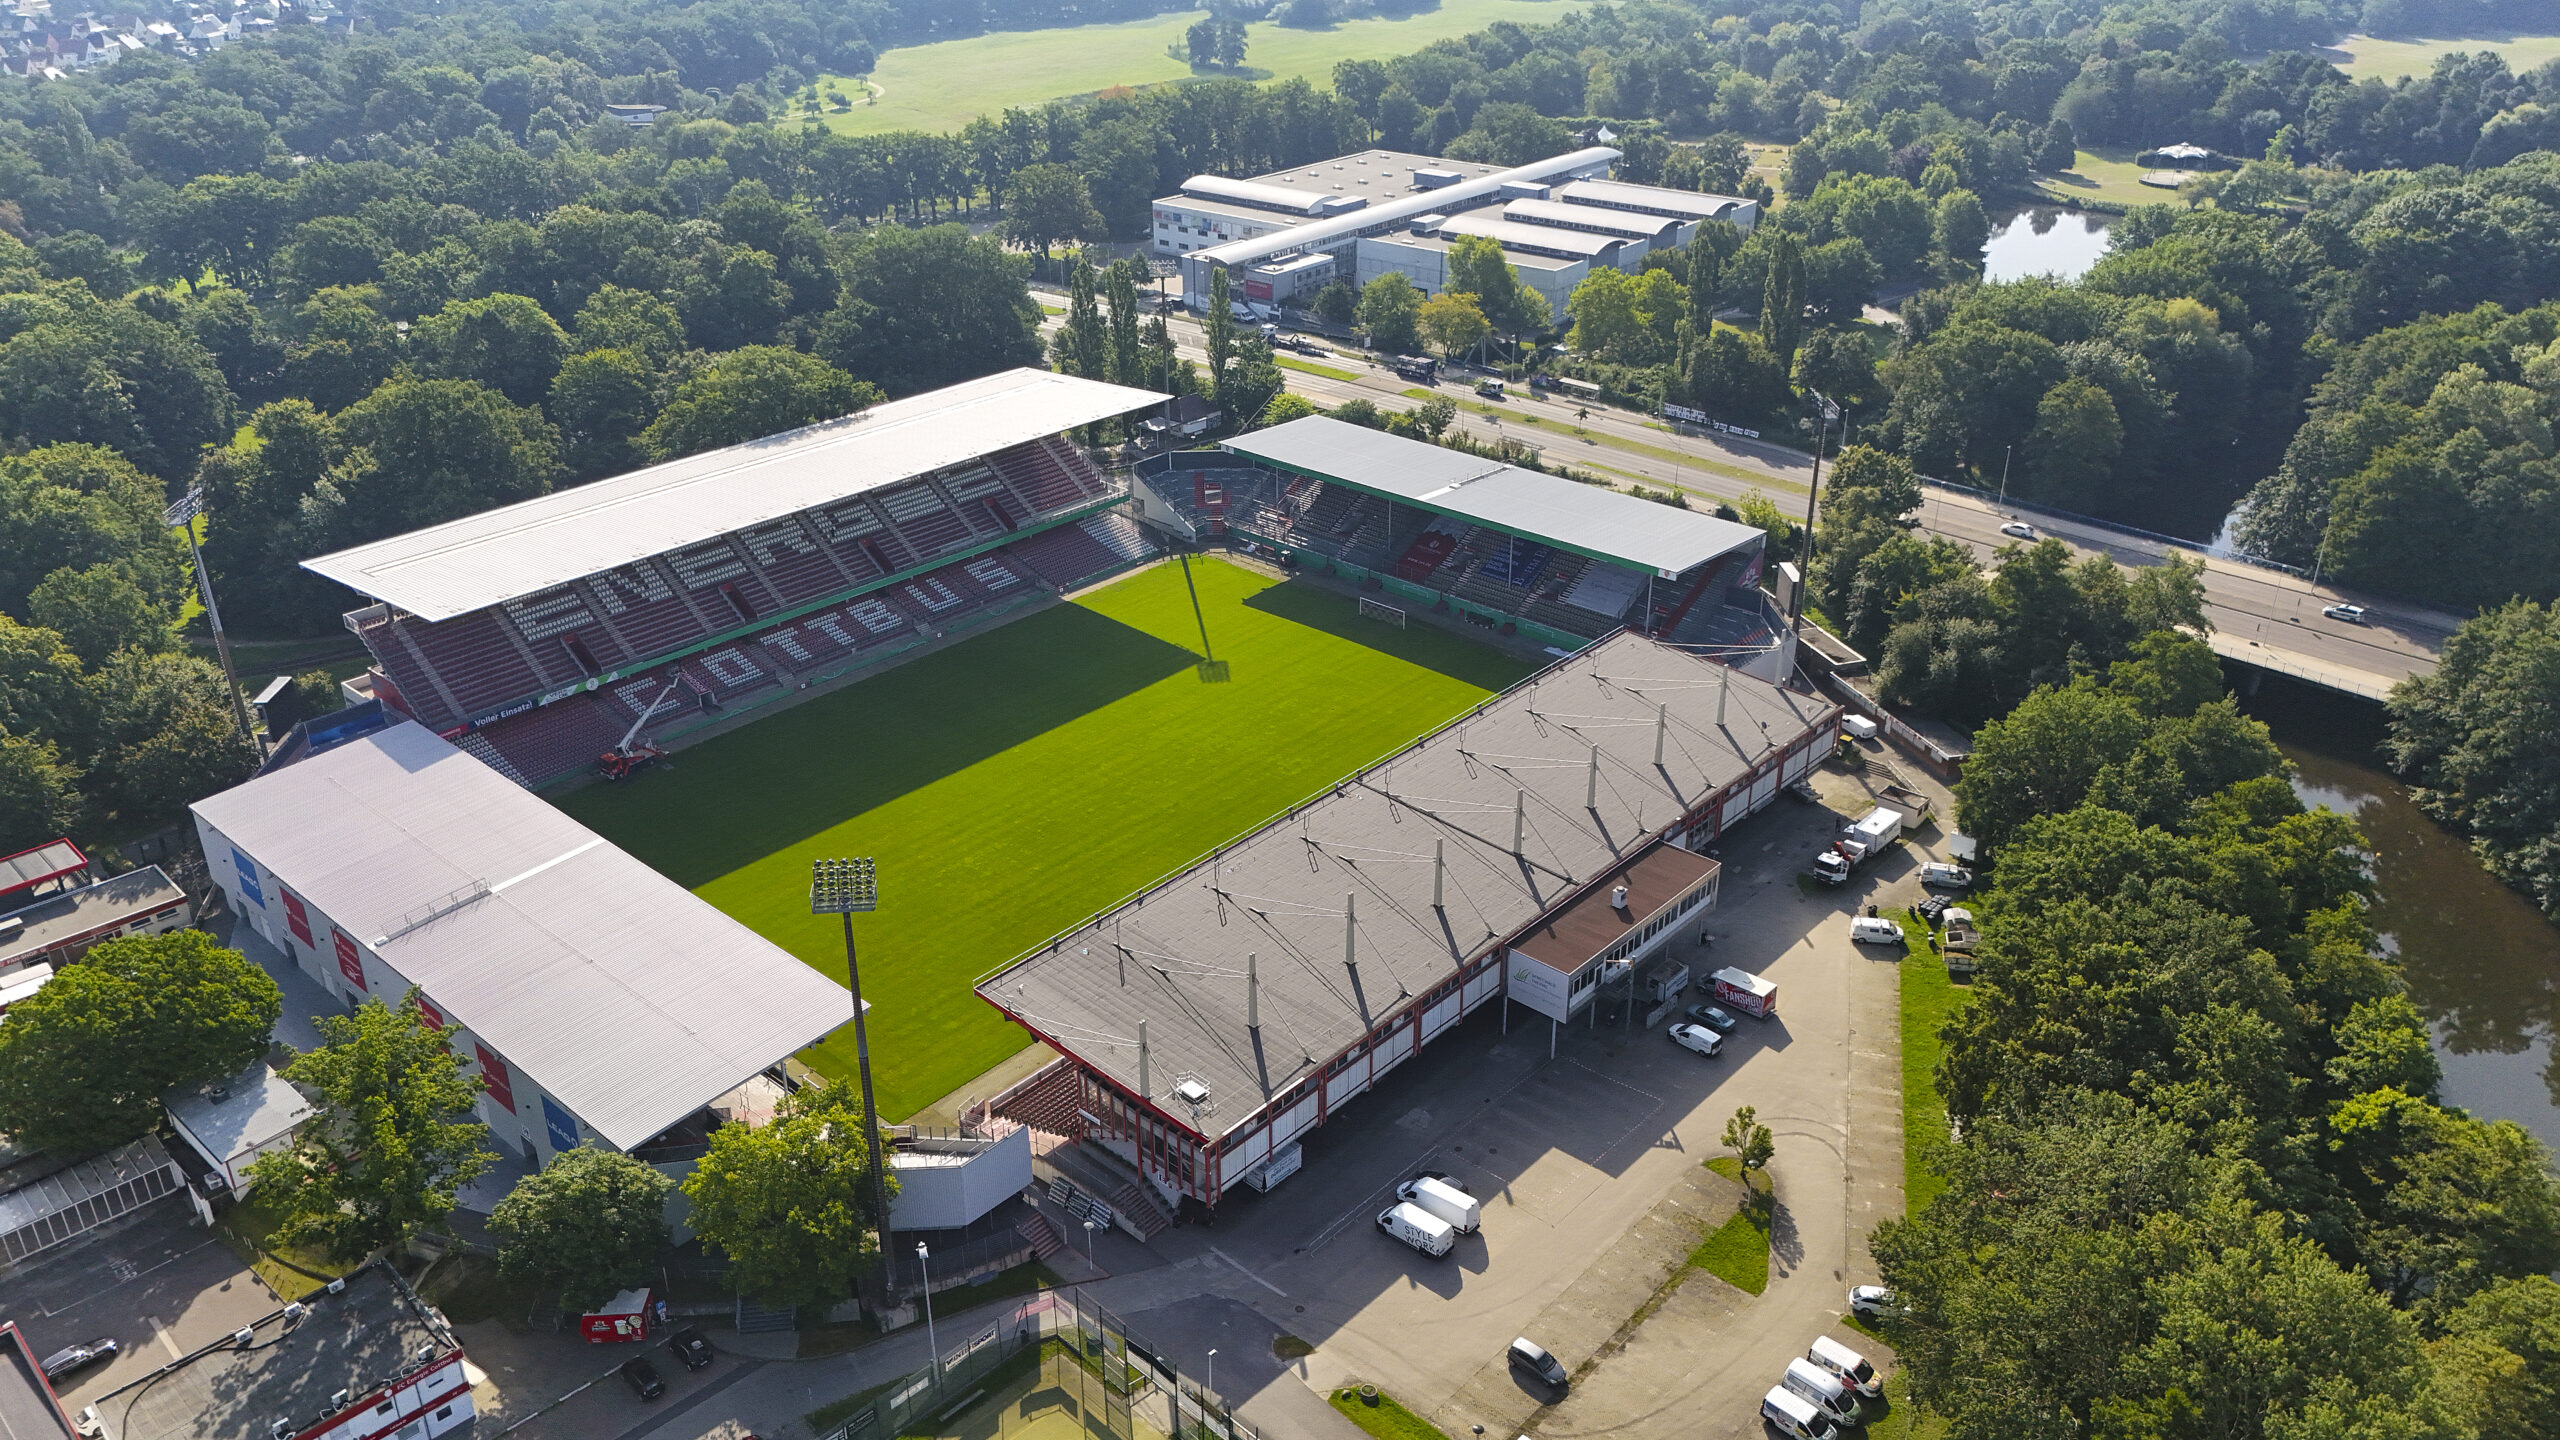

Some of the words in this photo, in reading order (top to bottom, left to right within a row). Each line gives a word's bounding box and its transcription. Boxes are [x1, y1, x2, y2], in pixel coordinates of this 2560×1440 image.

[501, 456, 1005, 642] ENERGIE
[614, 556, 1021, 717] COTTBUS
[474, 714, 499, 728] Voller
[500, 700, 533, 718] Einsatz!
[7, 950, 38, 965] FAN-SHOP
[1724, 990, 1761, 1007] FANSHOP
[1404, 1225, 1434, 1243] STYLE
[1404, 1234, 1436, 1252] WORK
[396, 1381, 406, 1391] FC
[406, 1369, 430, 1385] Energie
[430, 1356, 453, 1372] Cottbus
